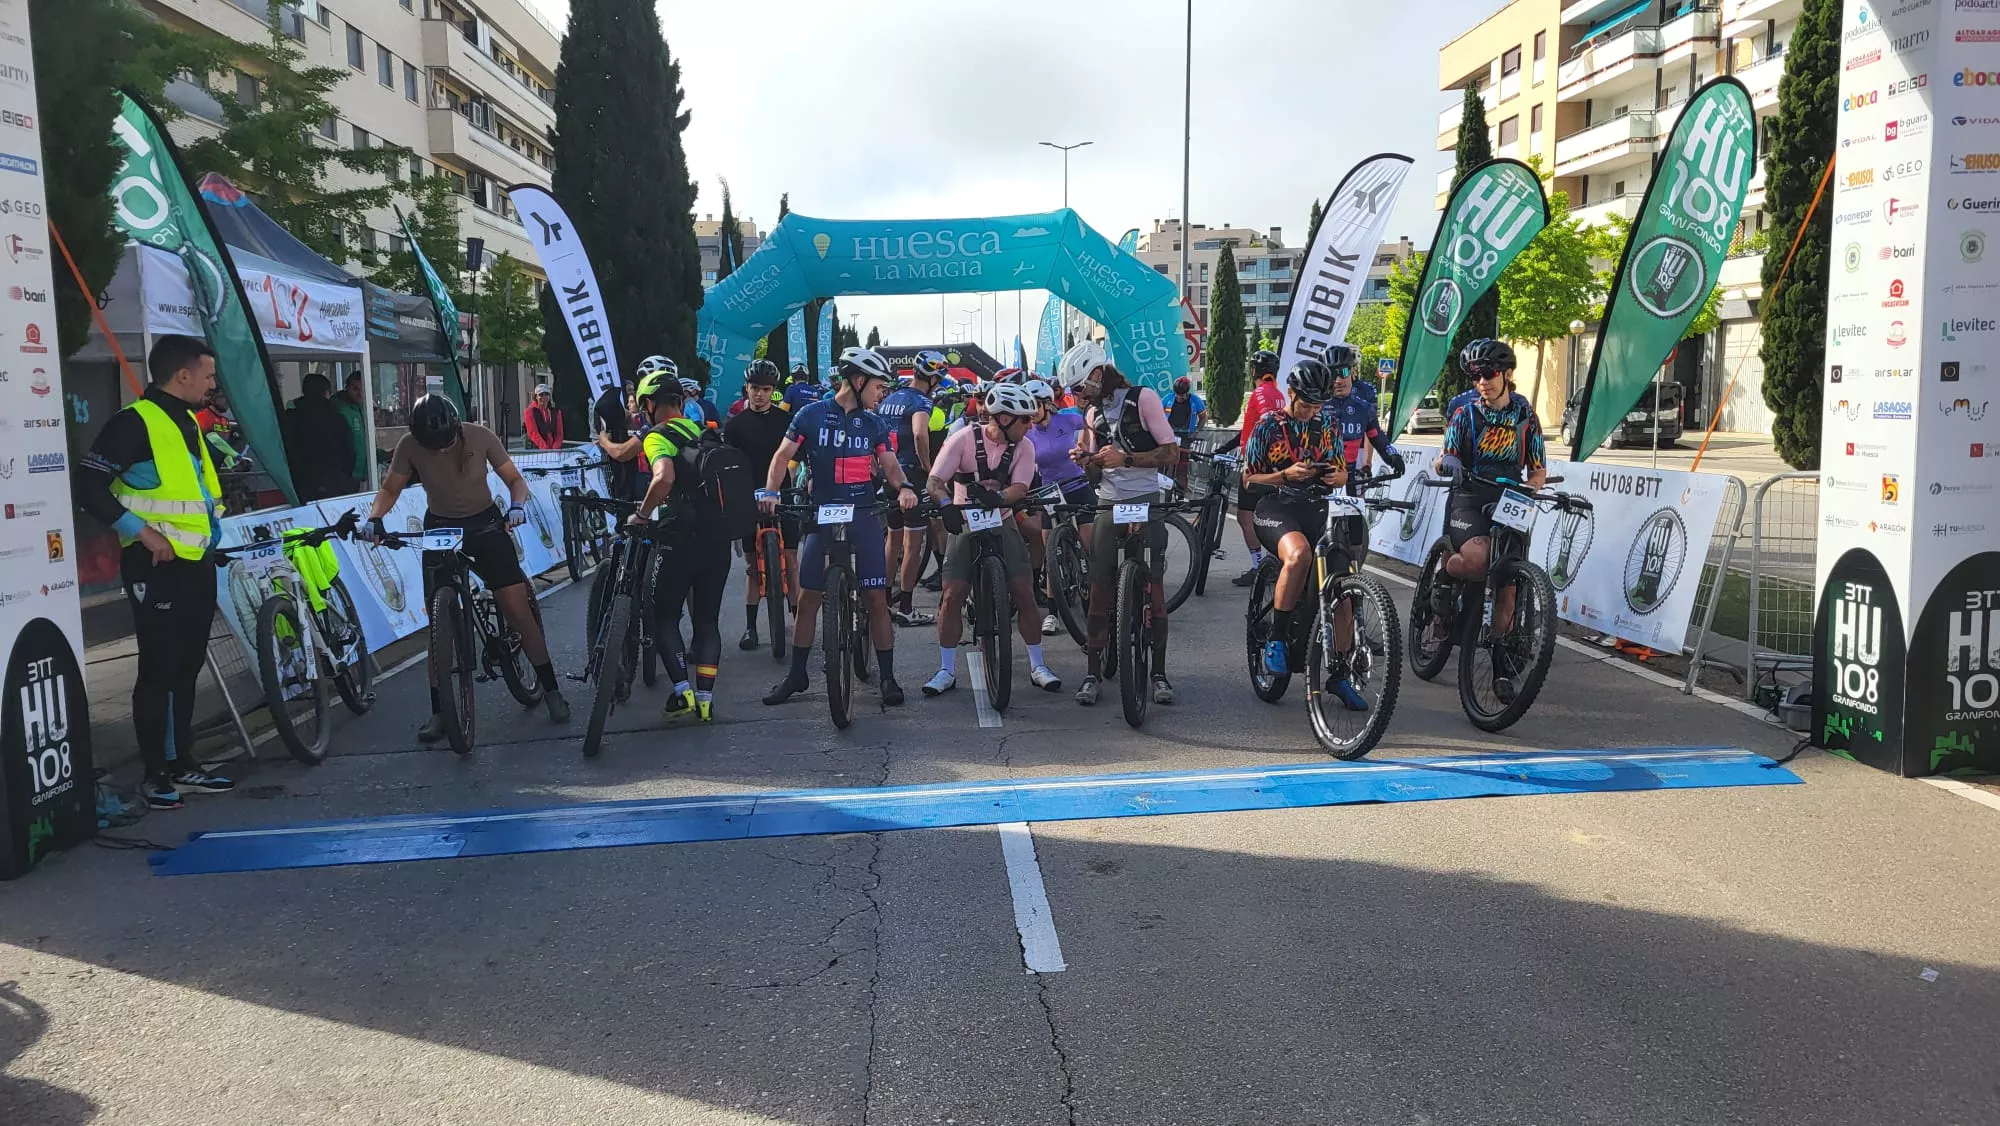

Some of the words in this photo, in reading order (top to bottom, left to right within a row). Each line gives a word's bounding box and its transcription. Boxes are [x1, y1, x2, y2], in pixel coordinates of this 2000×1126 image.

[1891, 5, 1907, 17] AUTO
[1889, 29, 1930, 53] marro
[1843, 90, 1878, 113] eboca
[1681, 96, 1747, 203] HU
[1851, 134, 1877, 145] VIDAL
[1896, 159, 1923, 176] GEO
[15, 200, 41, 215] GEO
[1667, 159, 1732, 241] 108
[1455, 173, 1537, 252] HU
[1843, 208, 1874, 223] sonepar
[1445, 222, 1499, 280] 108
[1893, 242, 1916, 259] barri
[1660, 248, 1687, 278] HU
[1657, 271, 1675, 291] 108
[1295, 243, 1361, 359] GOBIK
[1838, 324, 1868, 338] levitec
[1951, 317, 1996, 333] levitec
[1873, 400, 1913, 413] LASAOSA
[1341, 422, 1363, 434] 108
[28, 452, 65, 467] LASAOSA
[1589, 470, 1633, 495] HU108
[1635, 475, 1664, 498] BTT
[823, 507, 849, 519] 879
[971, 510, 994, 523] 917
[1502, 501, 1529, 521] 851
[434, 537, 452, 548] 12
[1648, 527, 1671, 556] HU
[1645, 554, 1663, 574] 108
[1833, 599, 1882, 667] HU
[1833, 657, 1879, 704] 108
[20, 674, 68, 753] HU
[1832, 693, 1878, 715] GRANFONDO
[27, 741, 72, 794] 108
[31, 779, 73, 806] GRANFONDO
